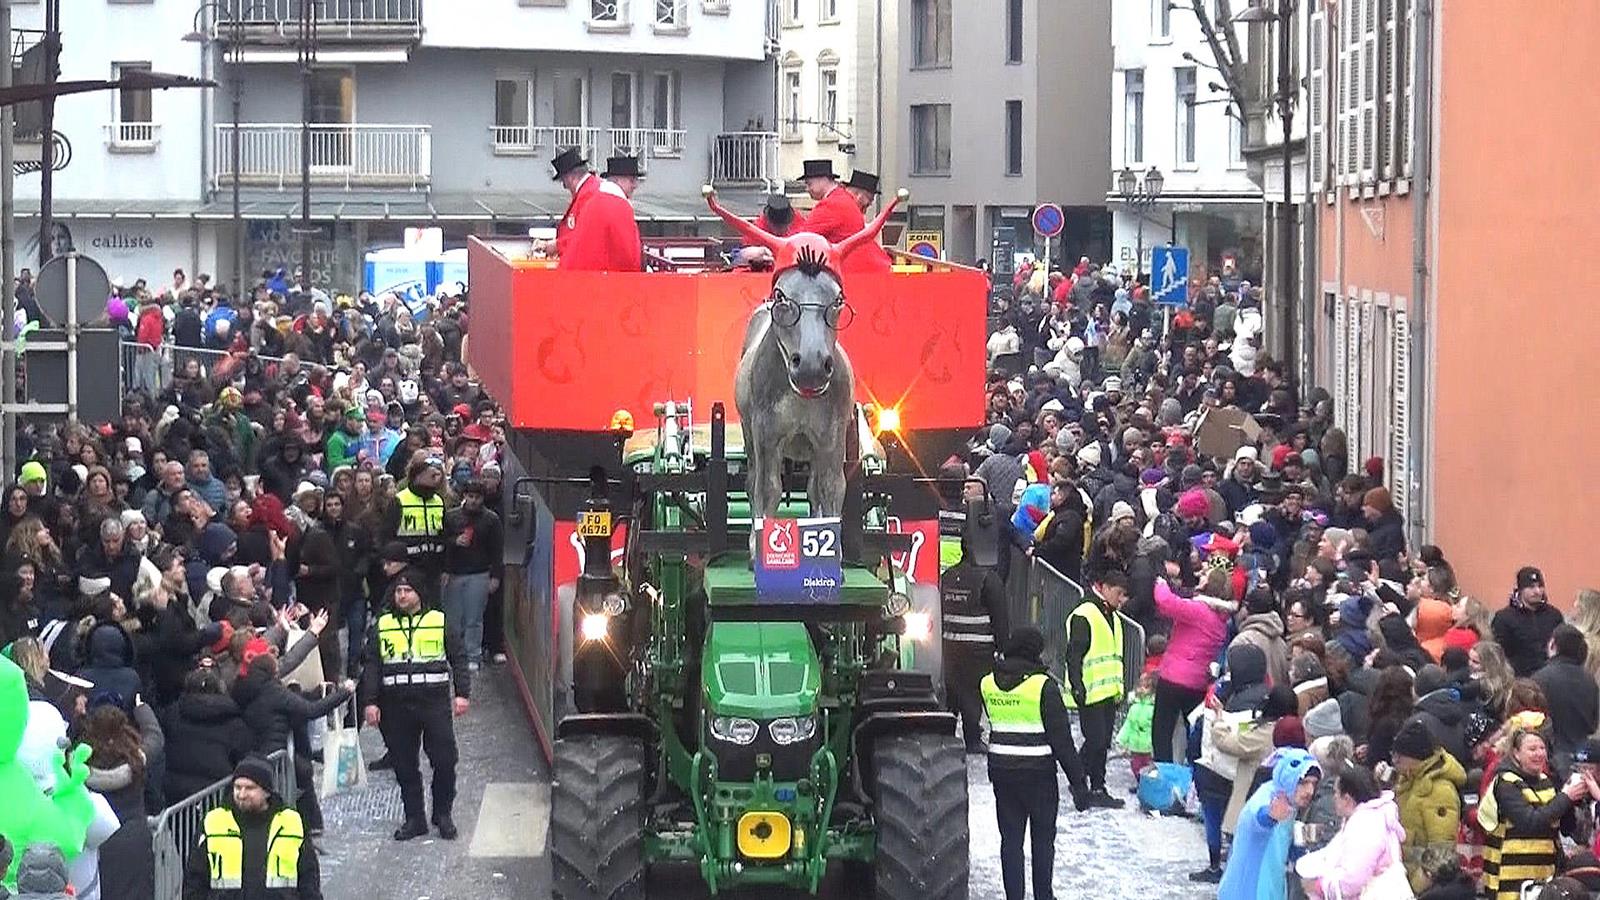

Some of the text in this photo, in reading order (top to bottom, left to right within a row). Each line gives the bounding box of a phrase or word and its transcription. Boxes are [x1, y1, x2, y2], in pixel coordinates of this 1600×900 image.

[92, 234, 153, 248] calliste
[802, 529, 836, 556] 52
[803, 577, 836, 587] Diekirch
